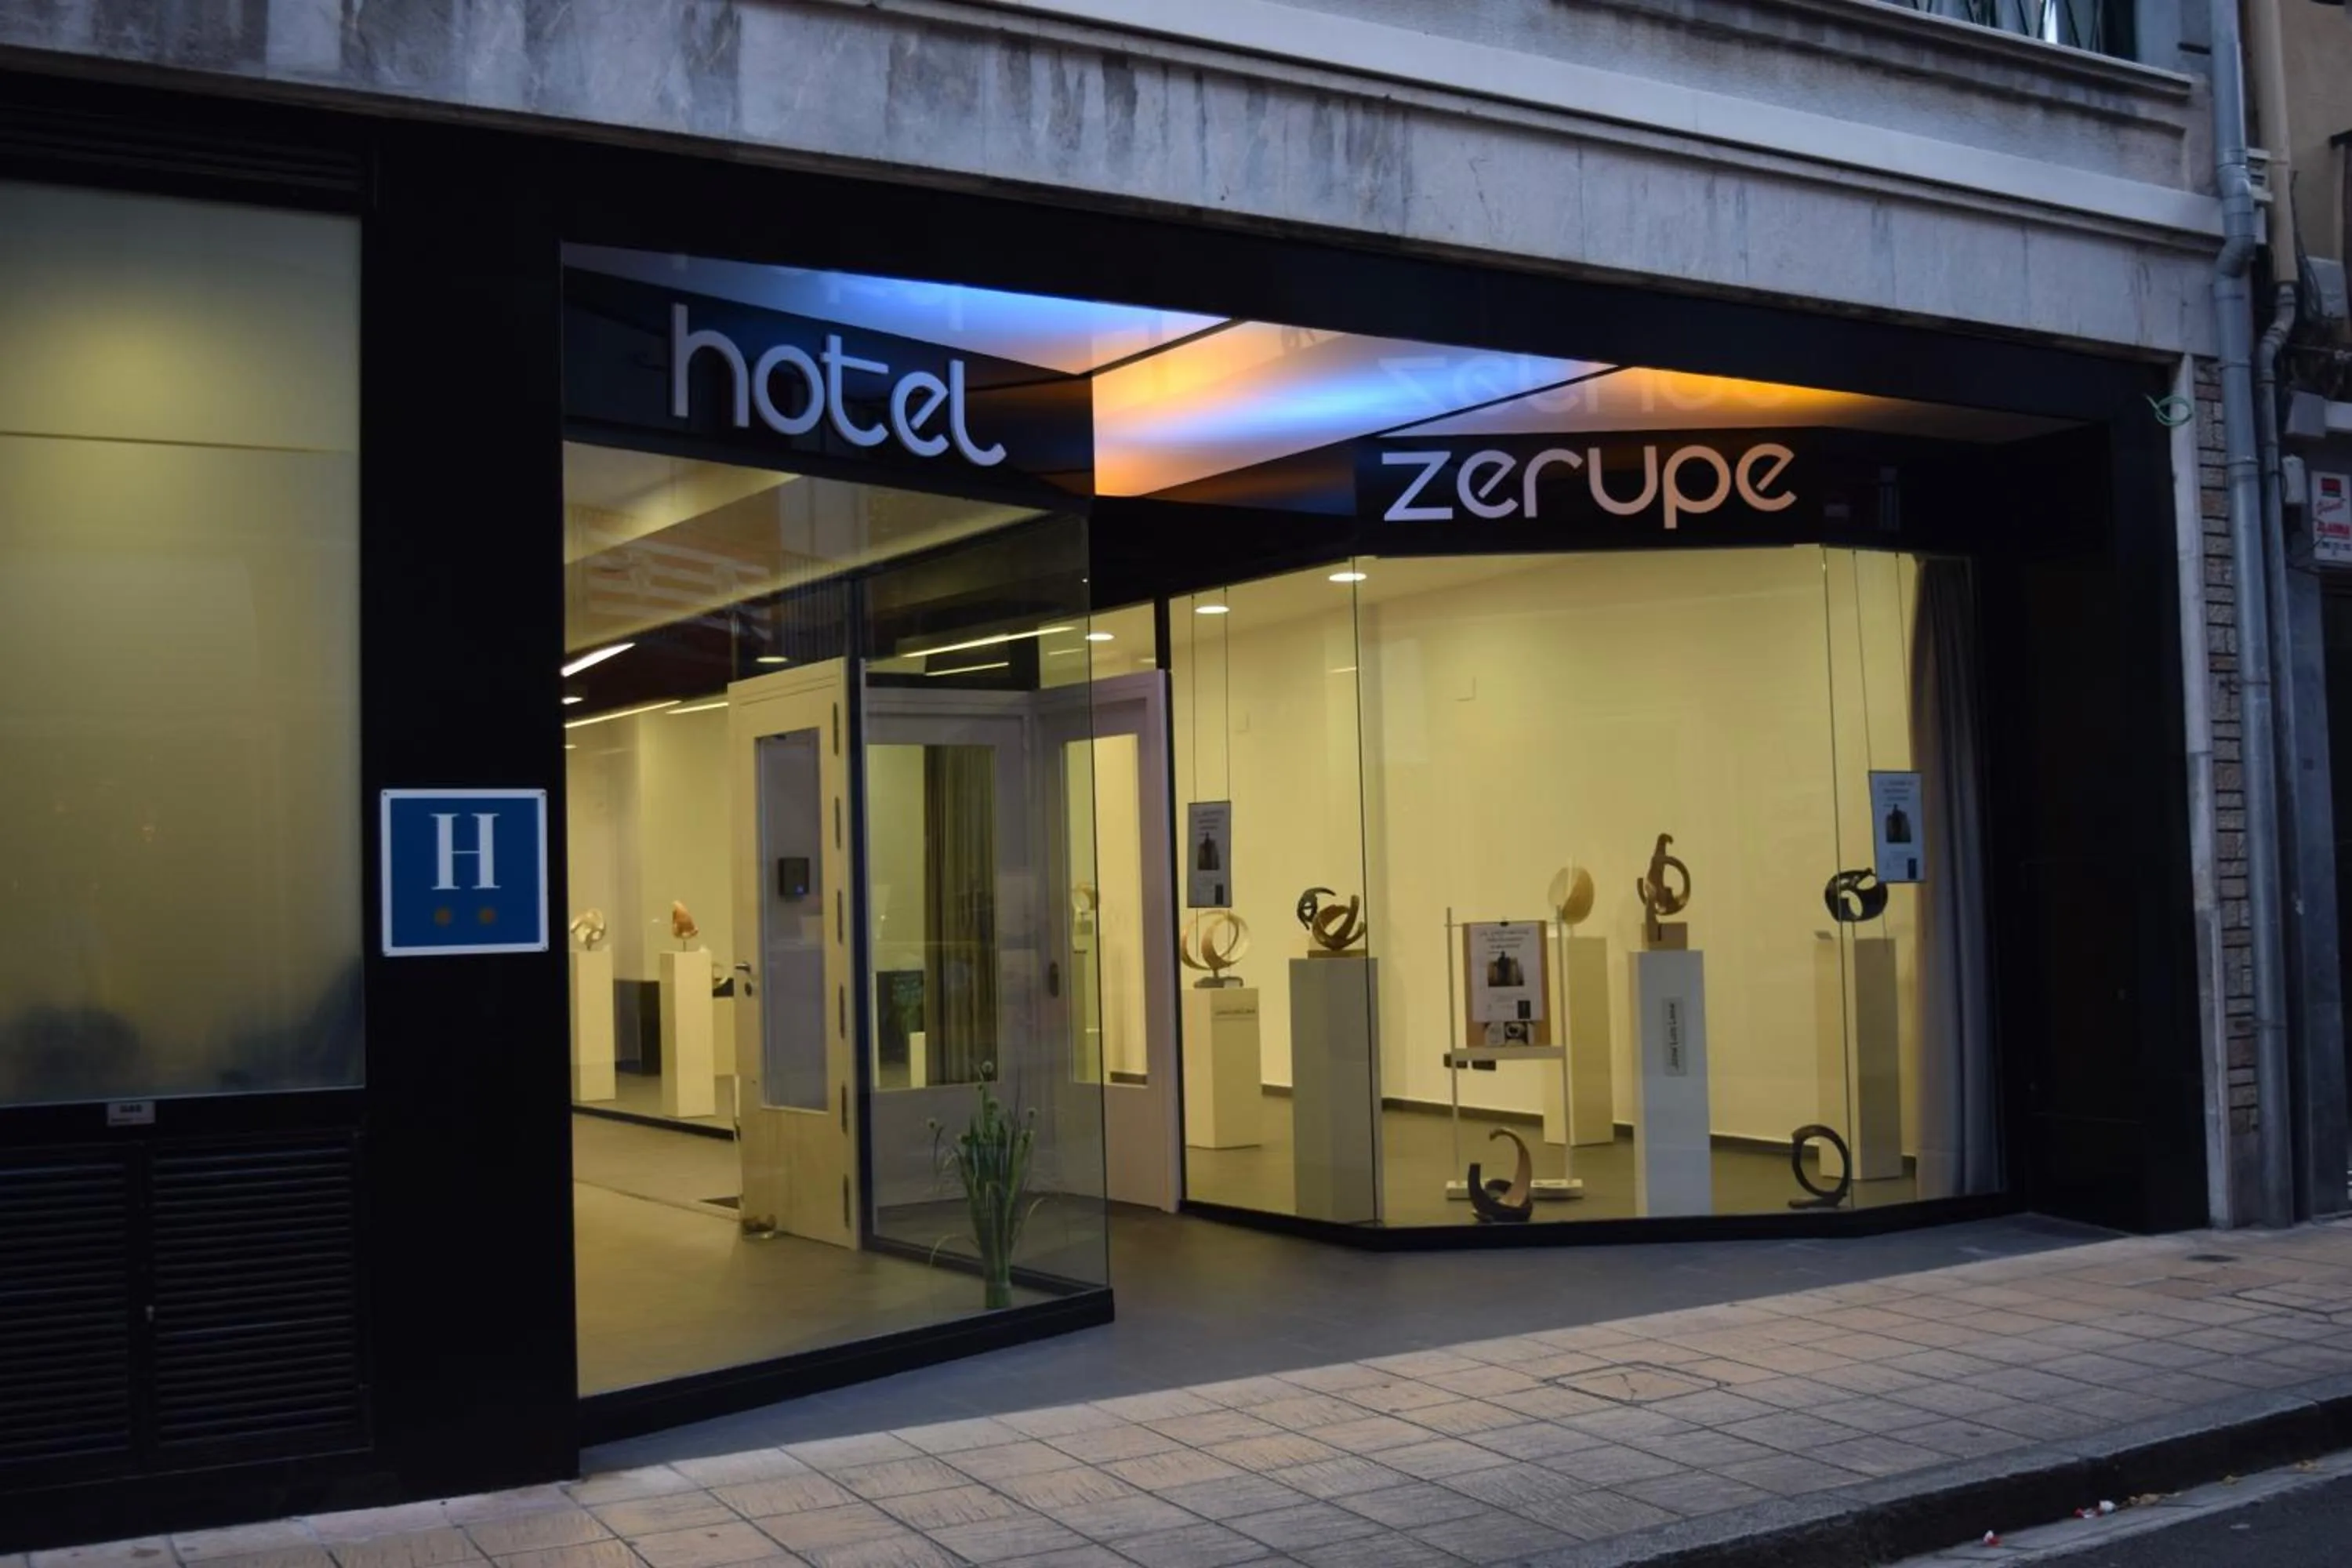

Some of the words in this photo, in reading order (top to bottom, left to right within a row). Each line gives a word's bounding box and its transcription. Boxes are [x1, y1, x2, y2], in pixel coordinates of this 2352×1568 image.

[671, 303, 1007, 466] hotel
[1381, 443, 1798, 529] zerupe
[429, 812, 502, 891] H
